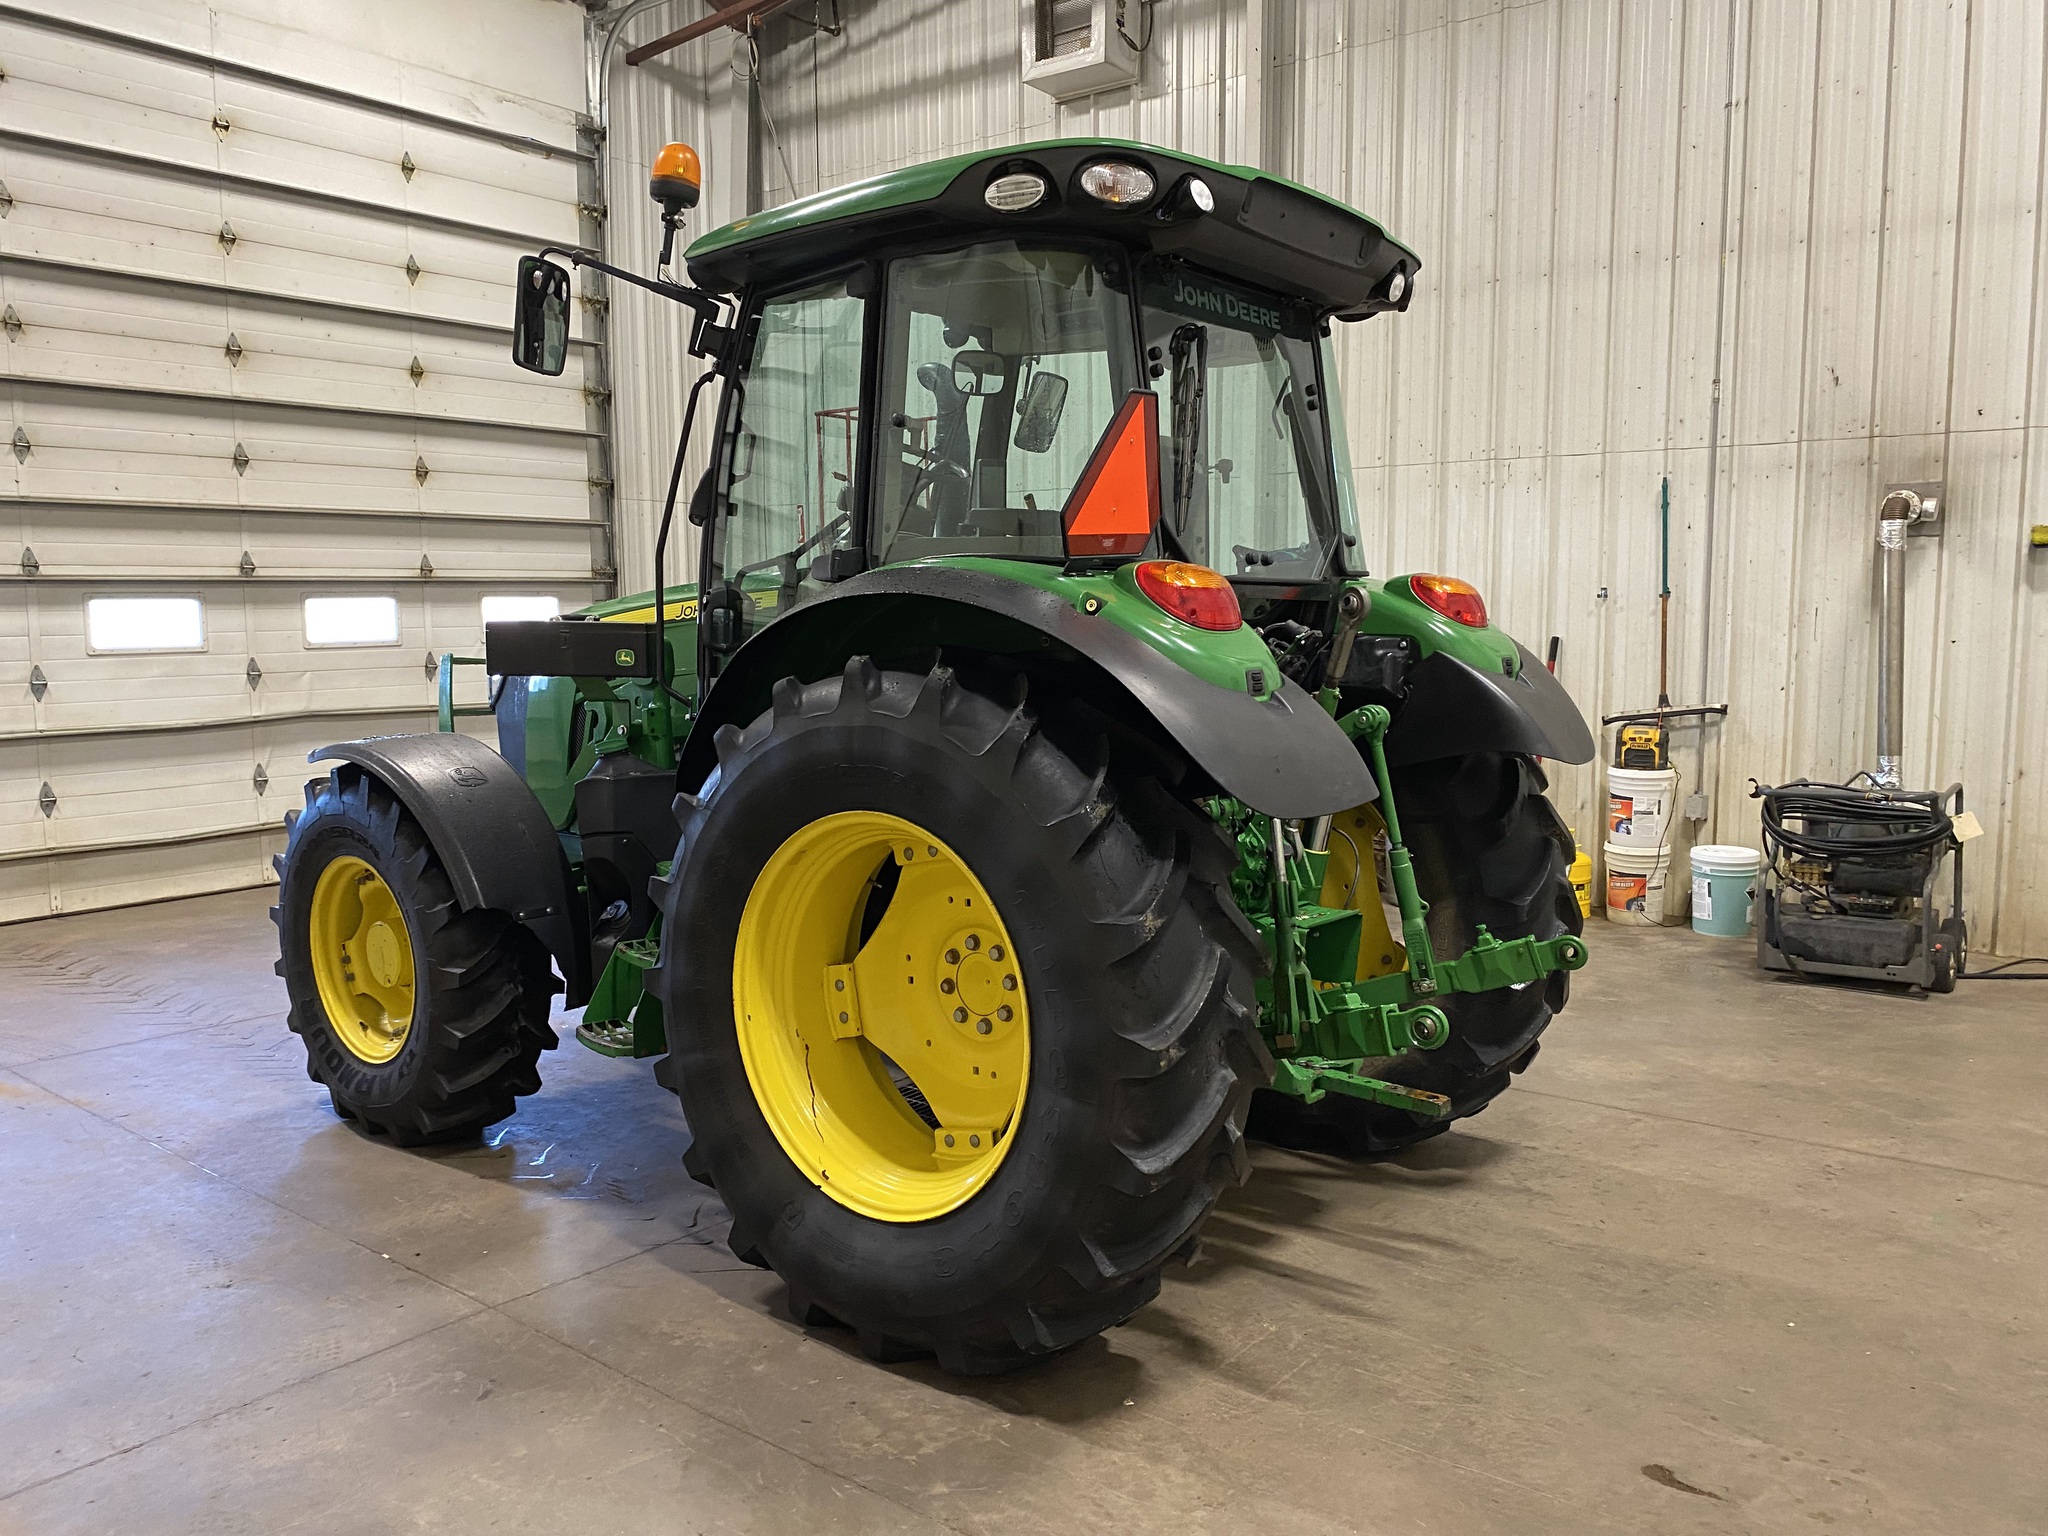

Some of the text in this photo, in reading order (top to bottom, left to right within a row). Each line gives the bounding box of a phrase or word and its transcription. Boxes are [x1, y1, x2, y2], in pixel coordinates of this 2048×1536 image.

[1174, 280, 1282, 330] JOHN DEERE
[675, 604, 698, 619] JOH
